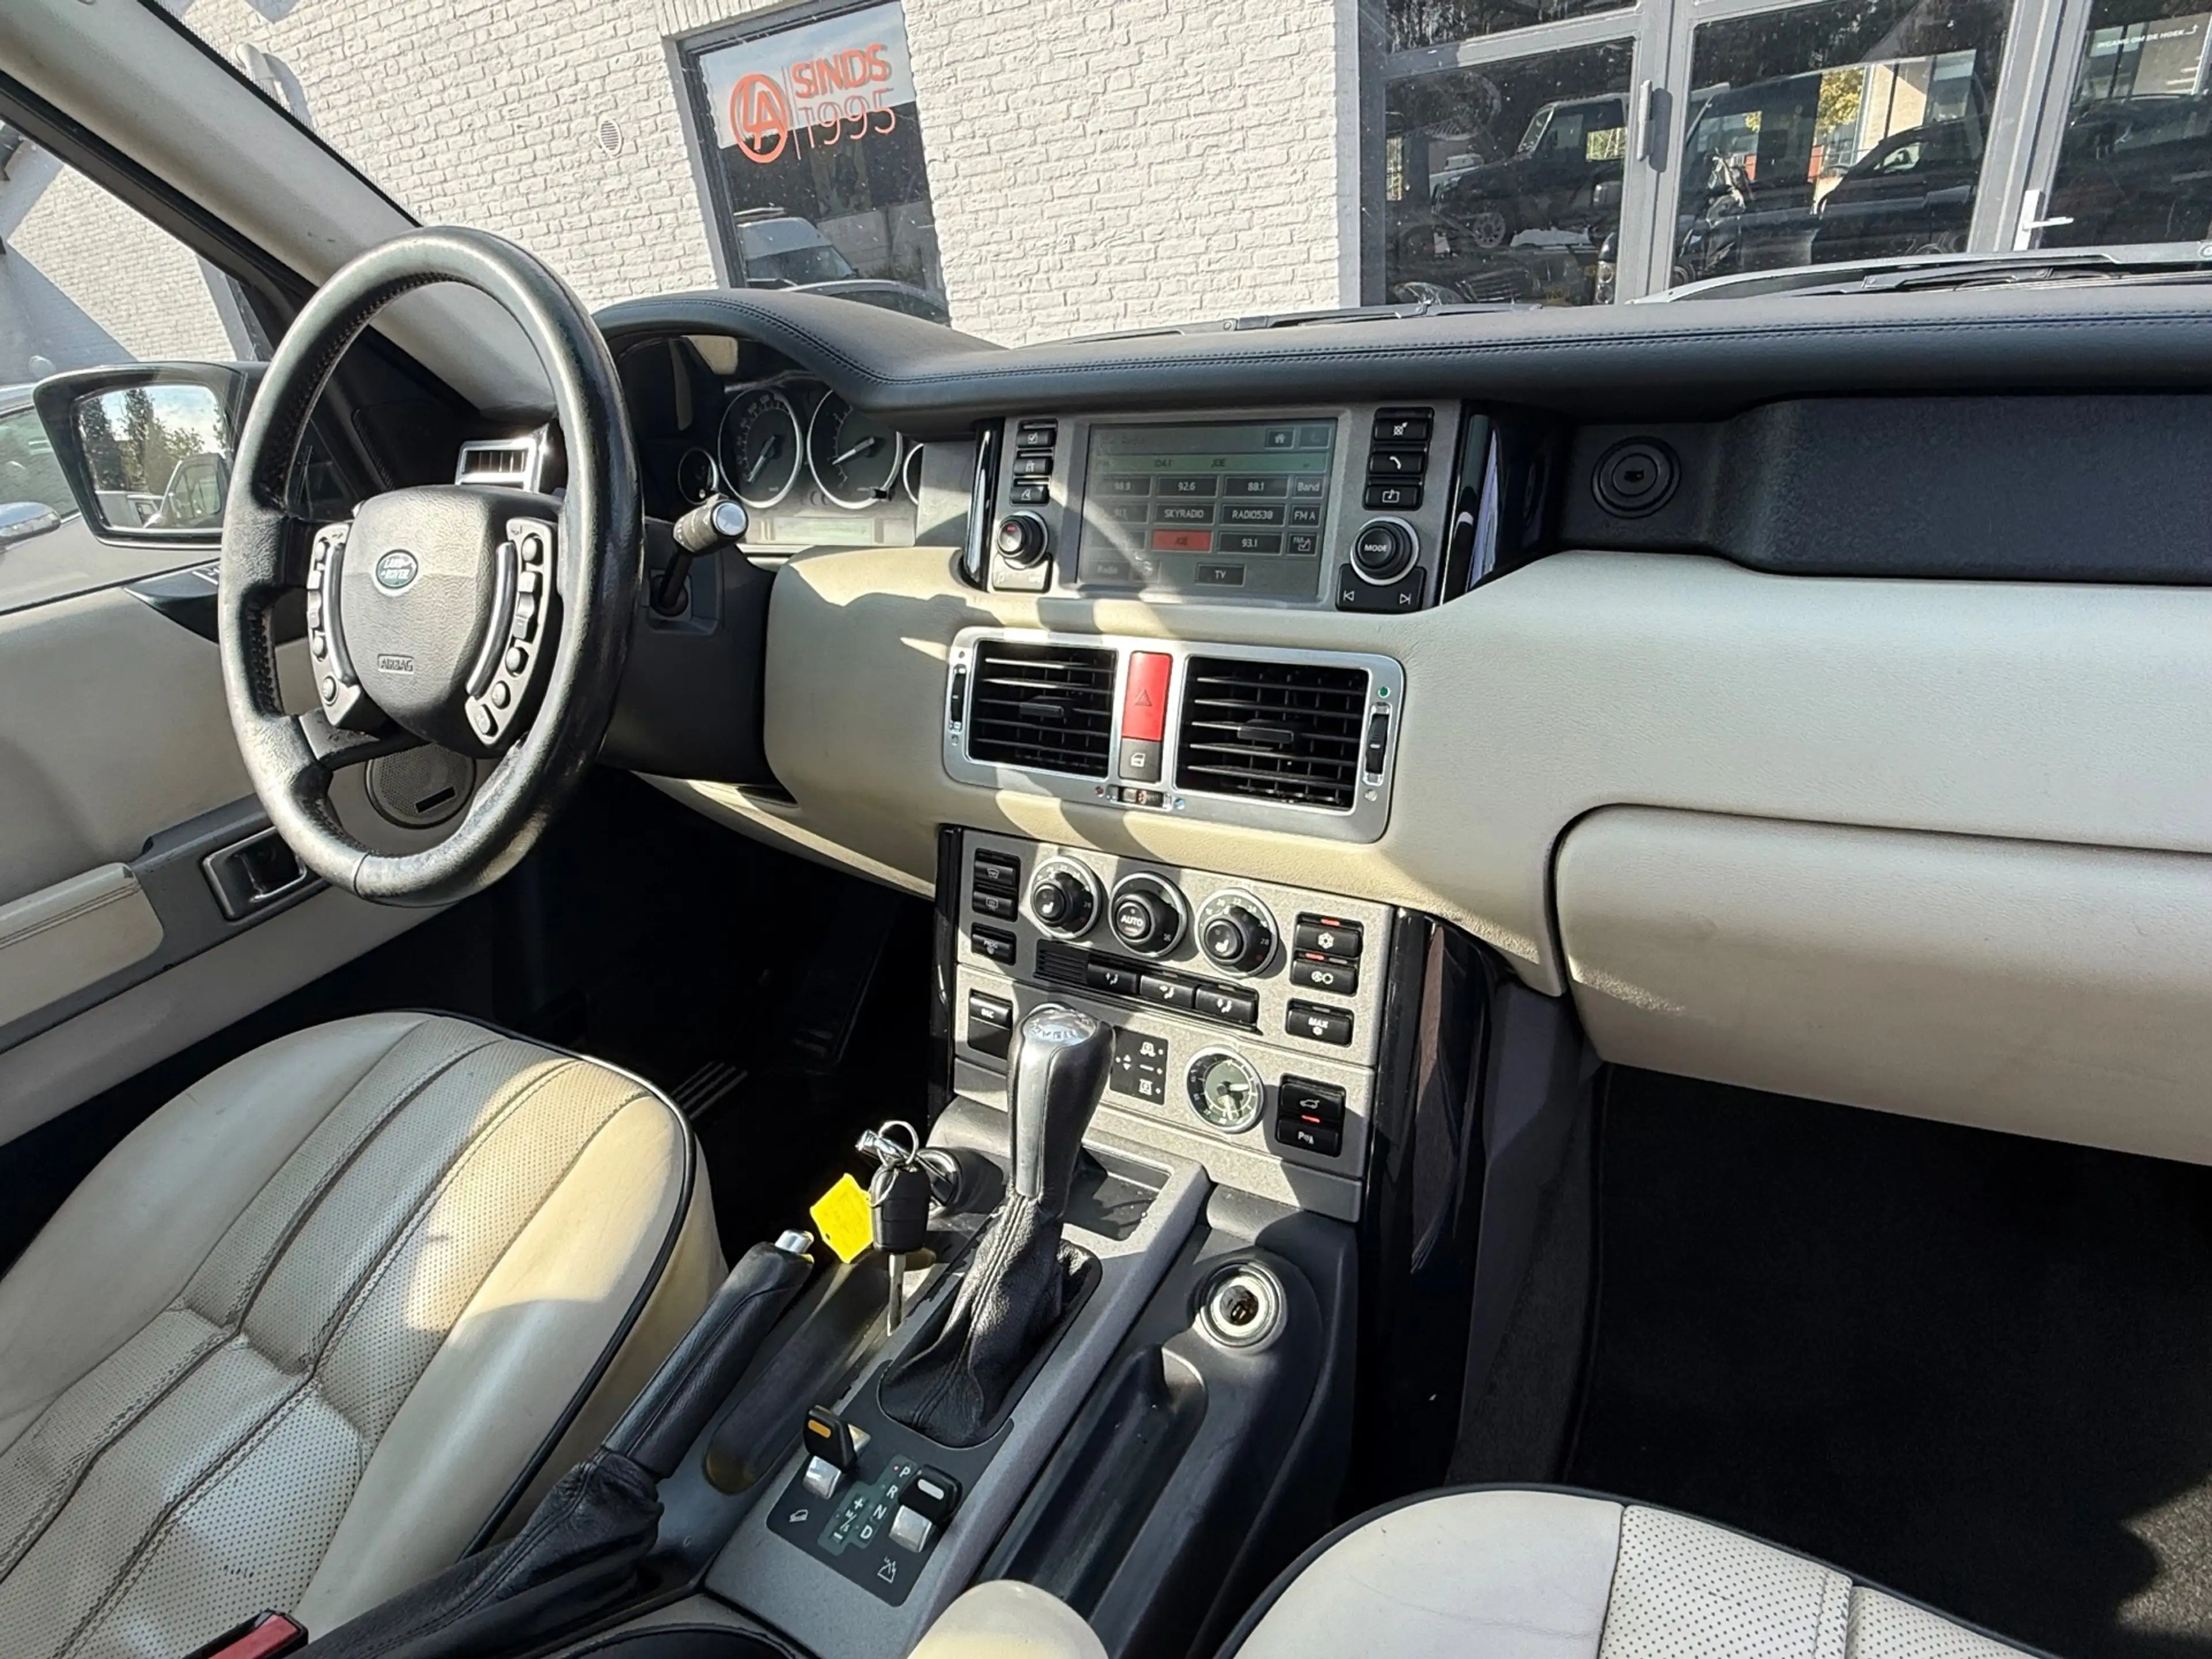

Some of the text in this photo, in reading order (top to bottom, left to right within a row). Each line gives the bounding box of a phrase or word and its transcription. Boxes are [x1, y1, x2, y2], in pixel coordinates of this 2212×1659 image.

[2130, 35, 2145, 43] OM
[2146, 33, 2159, 41] DE
[2160, 29, 2185, 39] HOEK
[791, 43, 891, 99] SINDS
[798, 88, 896, 149] 1995
[1297, 482, 1321, 491] Band
[1164, 509, 1205, 518] SKYRADIO
[1232, 509, 1274, 520] RADIO538
[1294, 511, 1316, 520] FM A
[1241, 537, 1258, 548] 93.1
[1363, 544, 1388, 552] MODE
[1215, 570, 1227, 579] TV
[1120, 914, 1143, 927] AUTO
[1308, 1017, 1329, 1029] MAX
[899, 1466, 911, 1478] P
[886, 1485, 898, 1499] R
[873, 1504, 888, 1520] N
[859, 1525, 873, 1539] D
